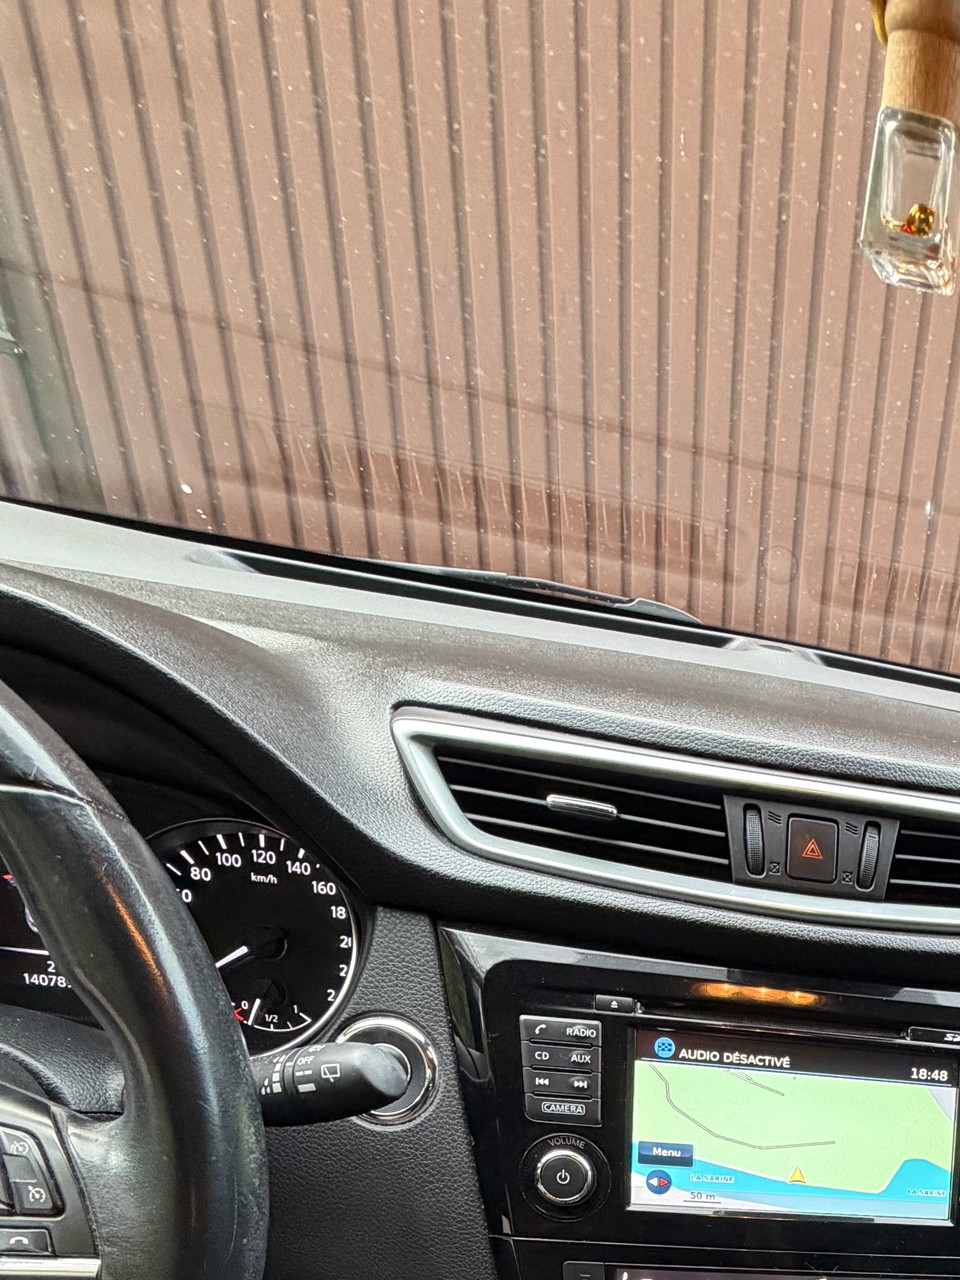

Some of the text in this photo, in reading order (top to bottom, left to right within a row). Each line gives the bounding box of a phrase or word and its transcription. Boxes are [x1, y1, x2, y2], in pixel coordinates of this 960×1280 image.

[216, 852, 241, 867] 100
[252, 849, 276, 864] 120
[286, 860, 311, 875] 140
[190, 867, 211, 881] 80
[251, 872, 278, 884] km/h
[312, 881, 336, 895] 160
[176, 888, 192, 902] 0
[331, 906, 346, 919] 18
[23, 972, 72, 989] 14078
[241, 1001, 249, 1009] 0
[293, 1005, 299, 1013] 1
[265, 1014, 279, 1023] 1/2
[566, 1027, 597, 1038] RADIO
[297, 1056, 315, 1065] OFF
[534, 1051, 550, 1060] CD
[570, 1053, 592, 1063] AUX
[679, 1048, 791, 1068] AUDIO DÉSACTIVÉ
[910, 1067, 948, 1082] 18:48
[543, 1103, 584, 1114] CAMERA
[547, 1137, 586, 1149] VOLUME
[652, 1146, 682, 1158] Menu
[690, 1191, 716, 1201] 50 m
